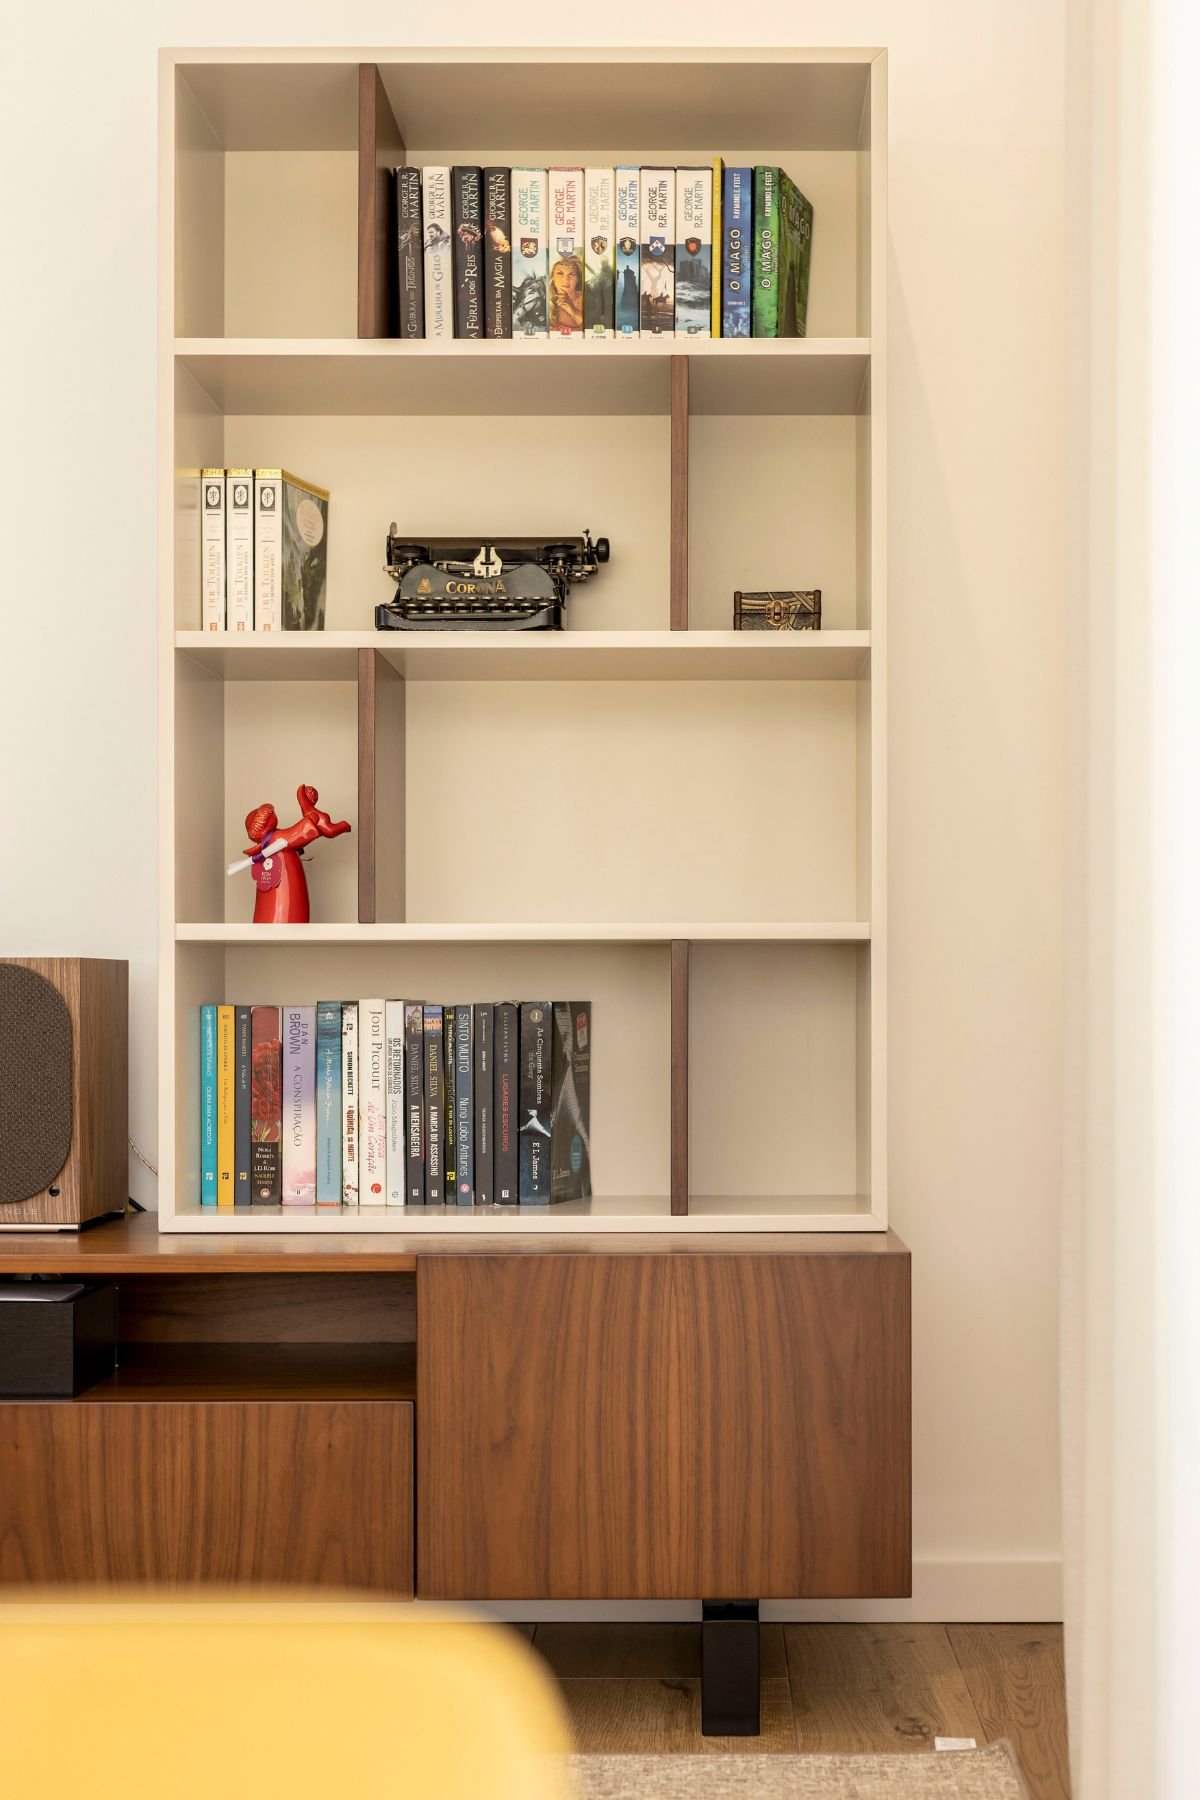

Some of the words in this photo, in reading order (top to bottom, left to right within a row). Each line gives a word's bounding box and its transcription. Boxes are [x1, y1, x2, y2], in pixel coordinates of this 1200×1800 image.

[409, 172, 419, 218] MARTIN
[435, 173, 445, 219] MARTIN
[469, 174, 478, 219] MARTIN
[496, 174, 505, 220] MARTIN
[519, 188, 528, 225] GEORGE
[530, 180, 539, 212] MARTIN
[555, 188, 564, 225] GEORGE
[566, 180, 576, 212] MARTIN
[589, 186, 598, 223] GEORGE
[600, 178, 609, 210] MARTIN
[619, 187, 627, 220] GEORGE
[629, 180, 637, 209] MARTIN
[649, 187, 657, 221] GEORGE
[659, 180, 667, 209] MARTIN
[685, 187, 693, 221] GEORGE
[695, 180, 703, 209] MARTIN
[465, 255, 477, 277] REIS
[730, 229, 740, 273] MAGO
[762, 230, 771, 271] MAGO
[406, 256, 417, 291] TRONOS
[432, 255, 444, 282] GELO
[494, 256, 505, 288] MAGIA
[762, 280, 771, 288] O
[730, 281, 740, 290] O
[408, 301, 417, 332] GUERRA
[435, 292, 444, 330] MURALHA
[466, 298, 478, 330] FÚRIA
[494, 301, 502, 335] DESPERTAR
[208, 545, 216, 585] TOLKIEN
[262, 547, 270, 588] TOLKIEN
[289, 1013, 300, 1055] BROWN
[370, 1010, 382, 1037] JODI
[459, 1014, 469, 1040] SINTO
[537, 1028, 543, 1037] As
[392, 1038, 401, 1048] OS
[410, 1044, 418, 1073] DANIEL
[459, 1044, 469, 1072] MUITO
[529, 1053, 534, 1061] de
[535, 1038, 544, 1073] Cinquenta
[371, 1042, 383, 1091] PICOULT
[392, 1049, 402, 1095] RETORNADOS
[410, 1075, 418, 1096] SILVA
[429, 1076, 437, 1097] SILVA
[292, 1074, 303, 1146] CONSPIRAÇÃO
[368, 1102, 375, 1114] de
[460, 1098, 469, 1118] Nuno
[410, 1112, 419, 1157] MENSAGEIRA
[430, 1133, 438, 1142] DO
[460, 1121, 469, 1142] Lobo
[366, 1136, 377, 1175] Coração
[430, 1143, 438, 1176] ASSASSINO
[460, 1144, 469, 1176] Antunes
